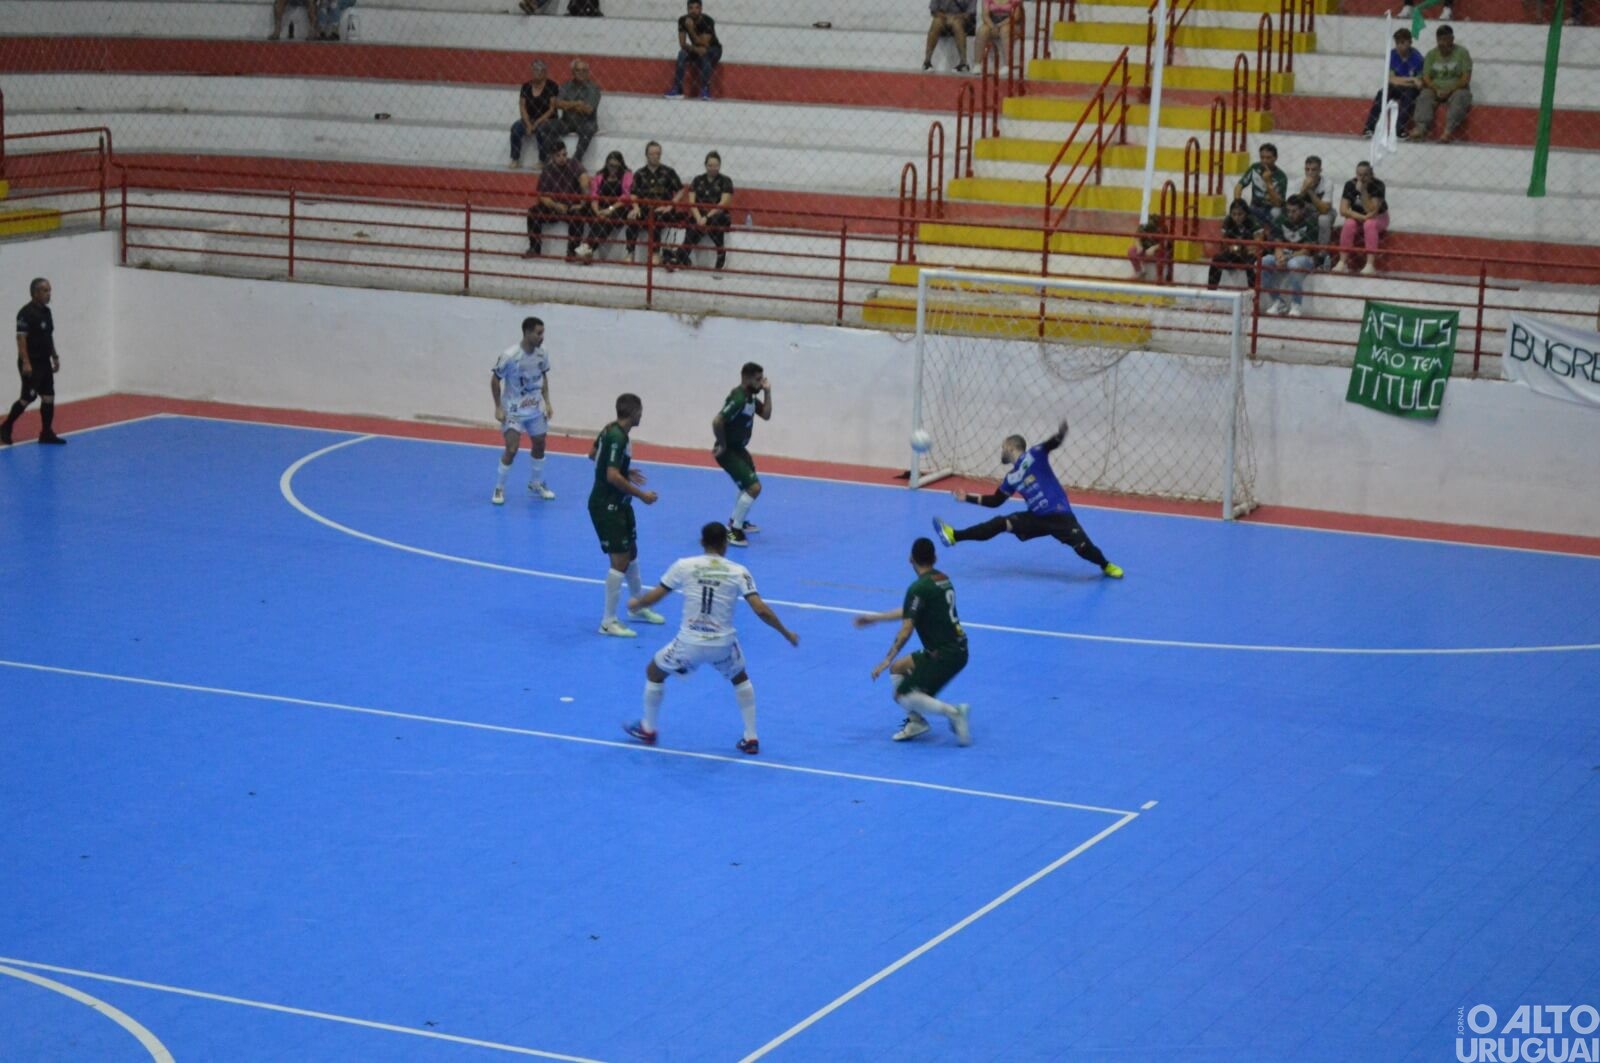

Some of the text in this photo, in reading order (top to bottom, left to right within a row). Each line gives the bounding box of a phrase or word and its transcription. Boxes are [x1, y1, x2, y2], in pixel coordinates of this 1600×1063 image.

[1365, 309, 1451, 348] AFUCS
[1371, 345, 1442, 372] NÃO TEM
[700, 585, 715, 615] 11
